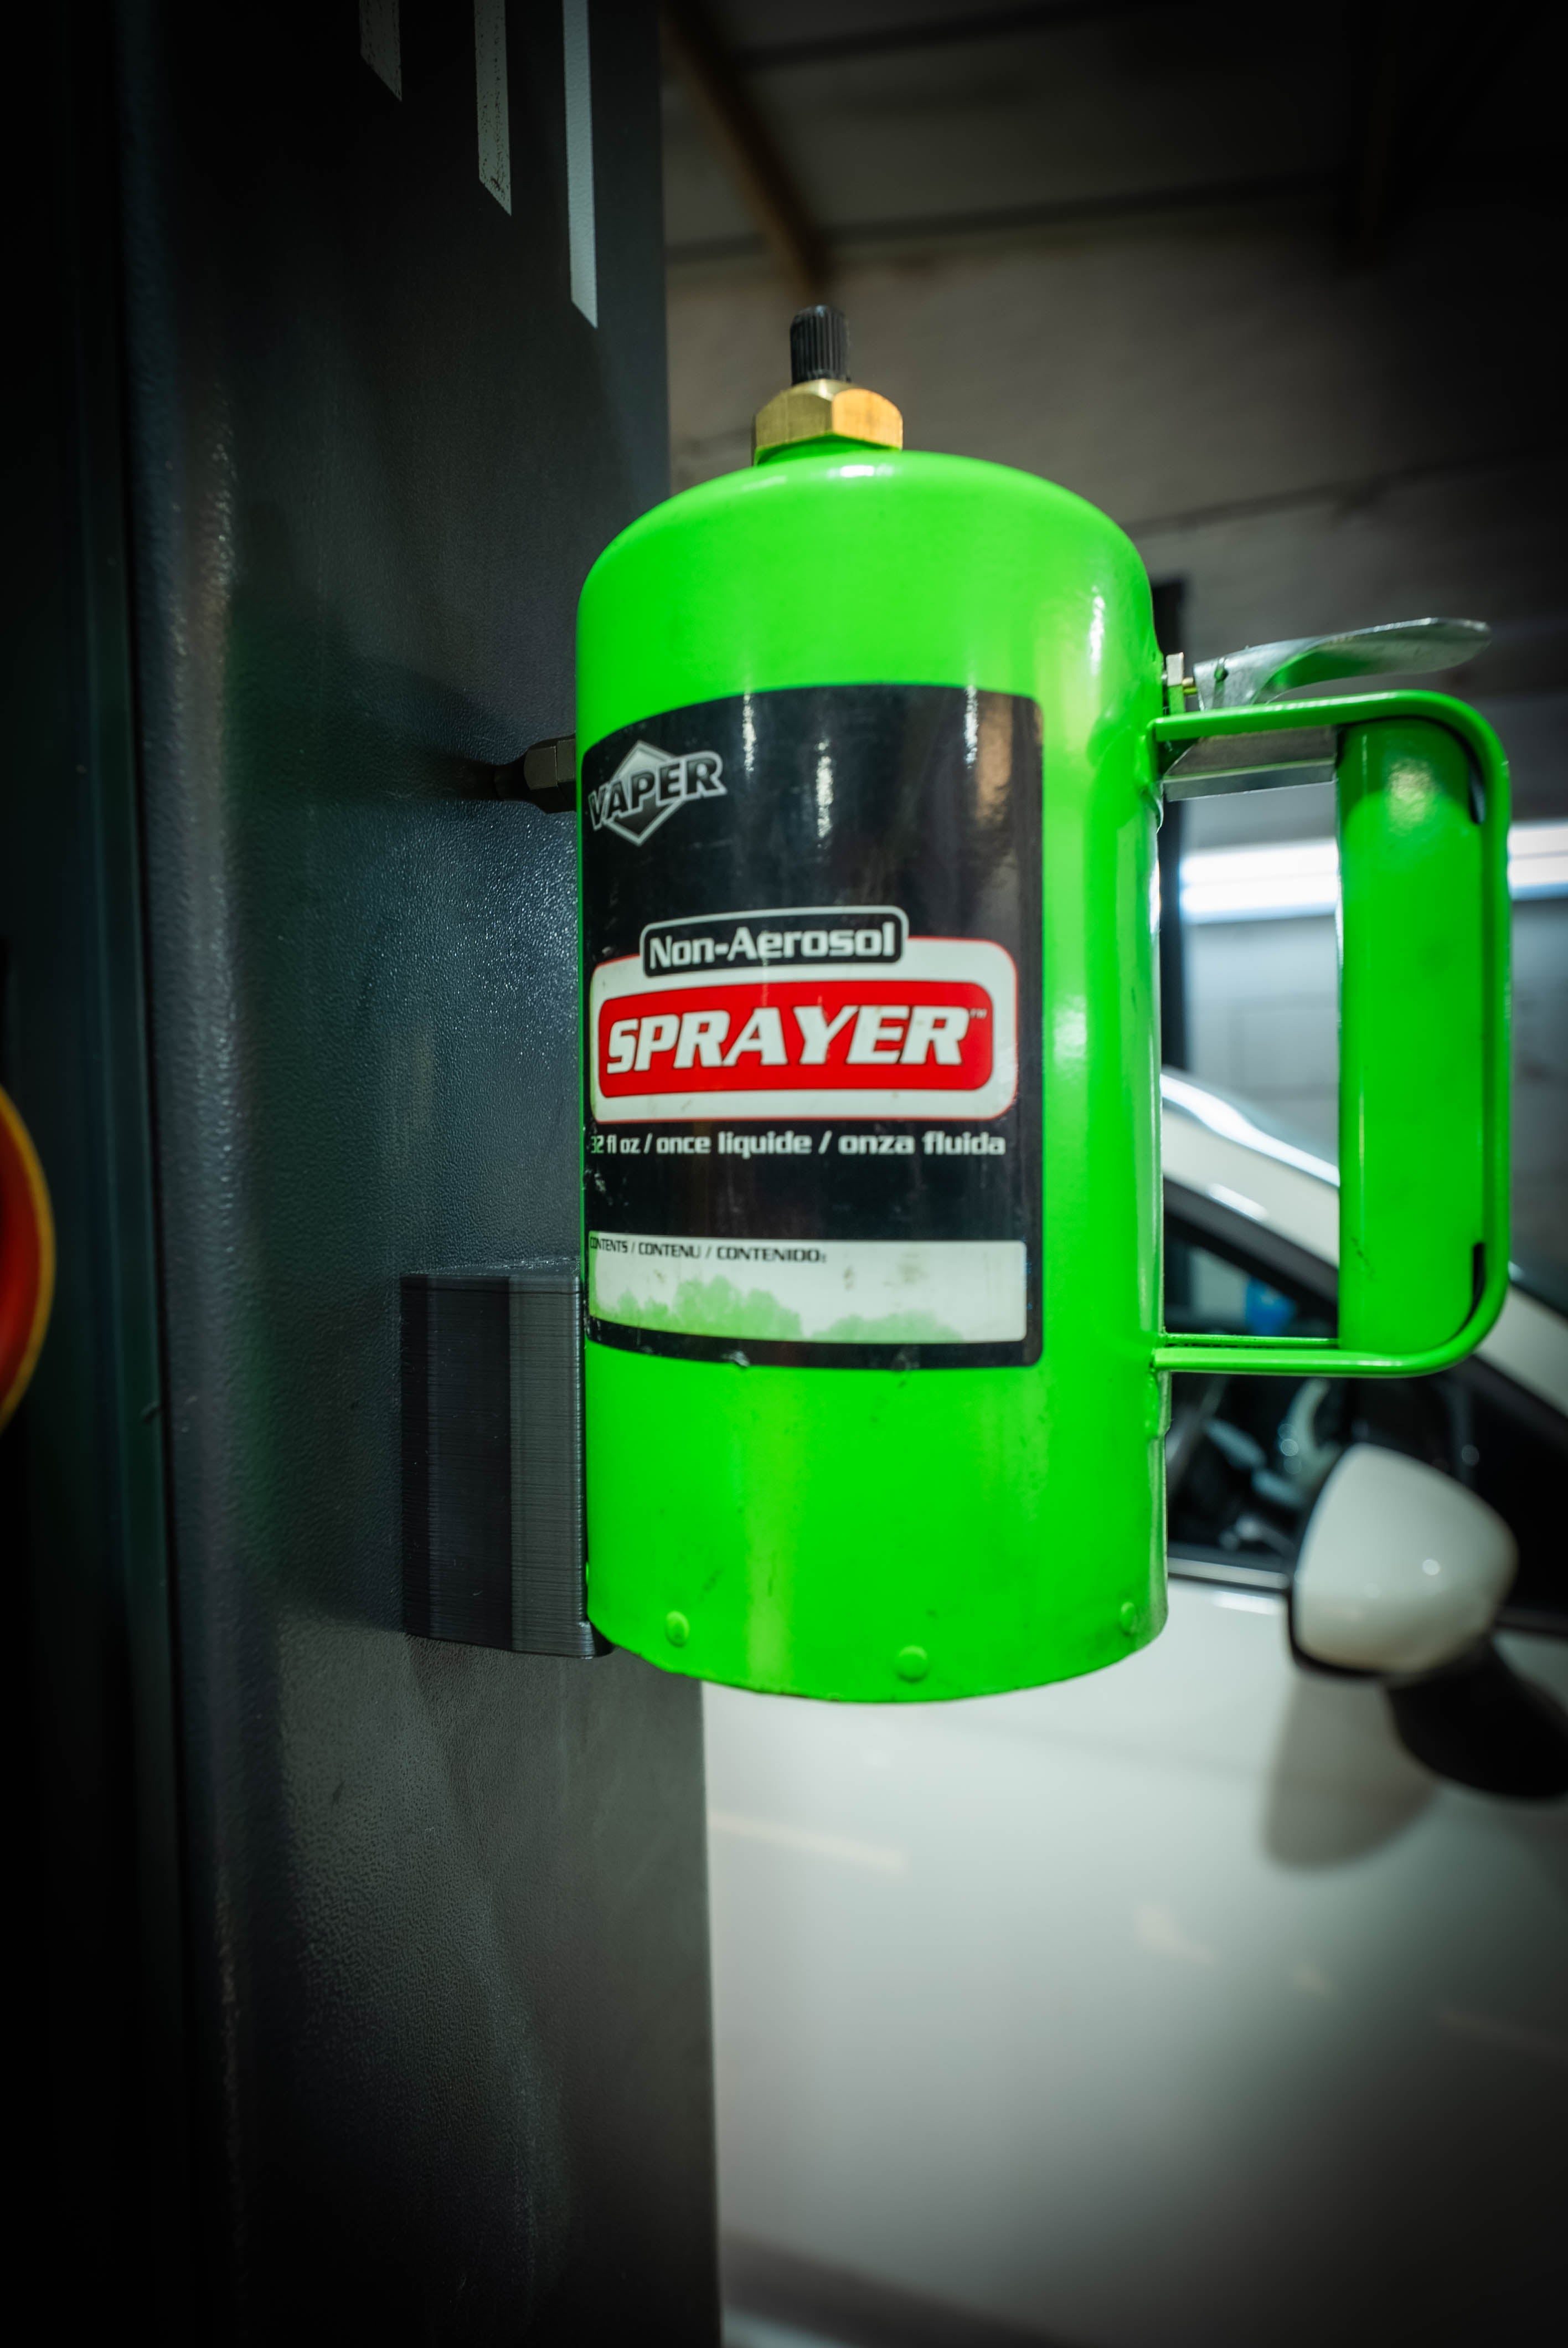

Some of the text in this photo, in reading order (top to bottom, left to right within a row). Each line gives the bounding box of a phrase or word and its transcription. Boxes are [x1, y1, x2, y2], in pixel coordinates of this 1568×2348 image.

[588, 750, 728, 830] VAPER
[649, 921, 896, 970] Non-Aerosol
[606, 1005, 970, 1074] SPRAYER
[606, 1134, 617, 1154] fl
[619, 1137, 641, 1154] oz
[656, 1136, 711, 1155] once
[718, 1130, 813, 1160] liquide
[838, 1135, 916, 1155] onza
[922, 1130, 1007, 1156] fluida
[590, 1237, 628, 1254] CONTENTS
[638, 1242, 702, 1259] CONTENU
